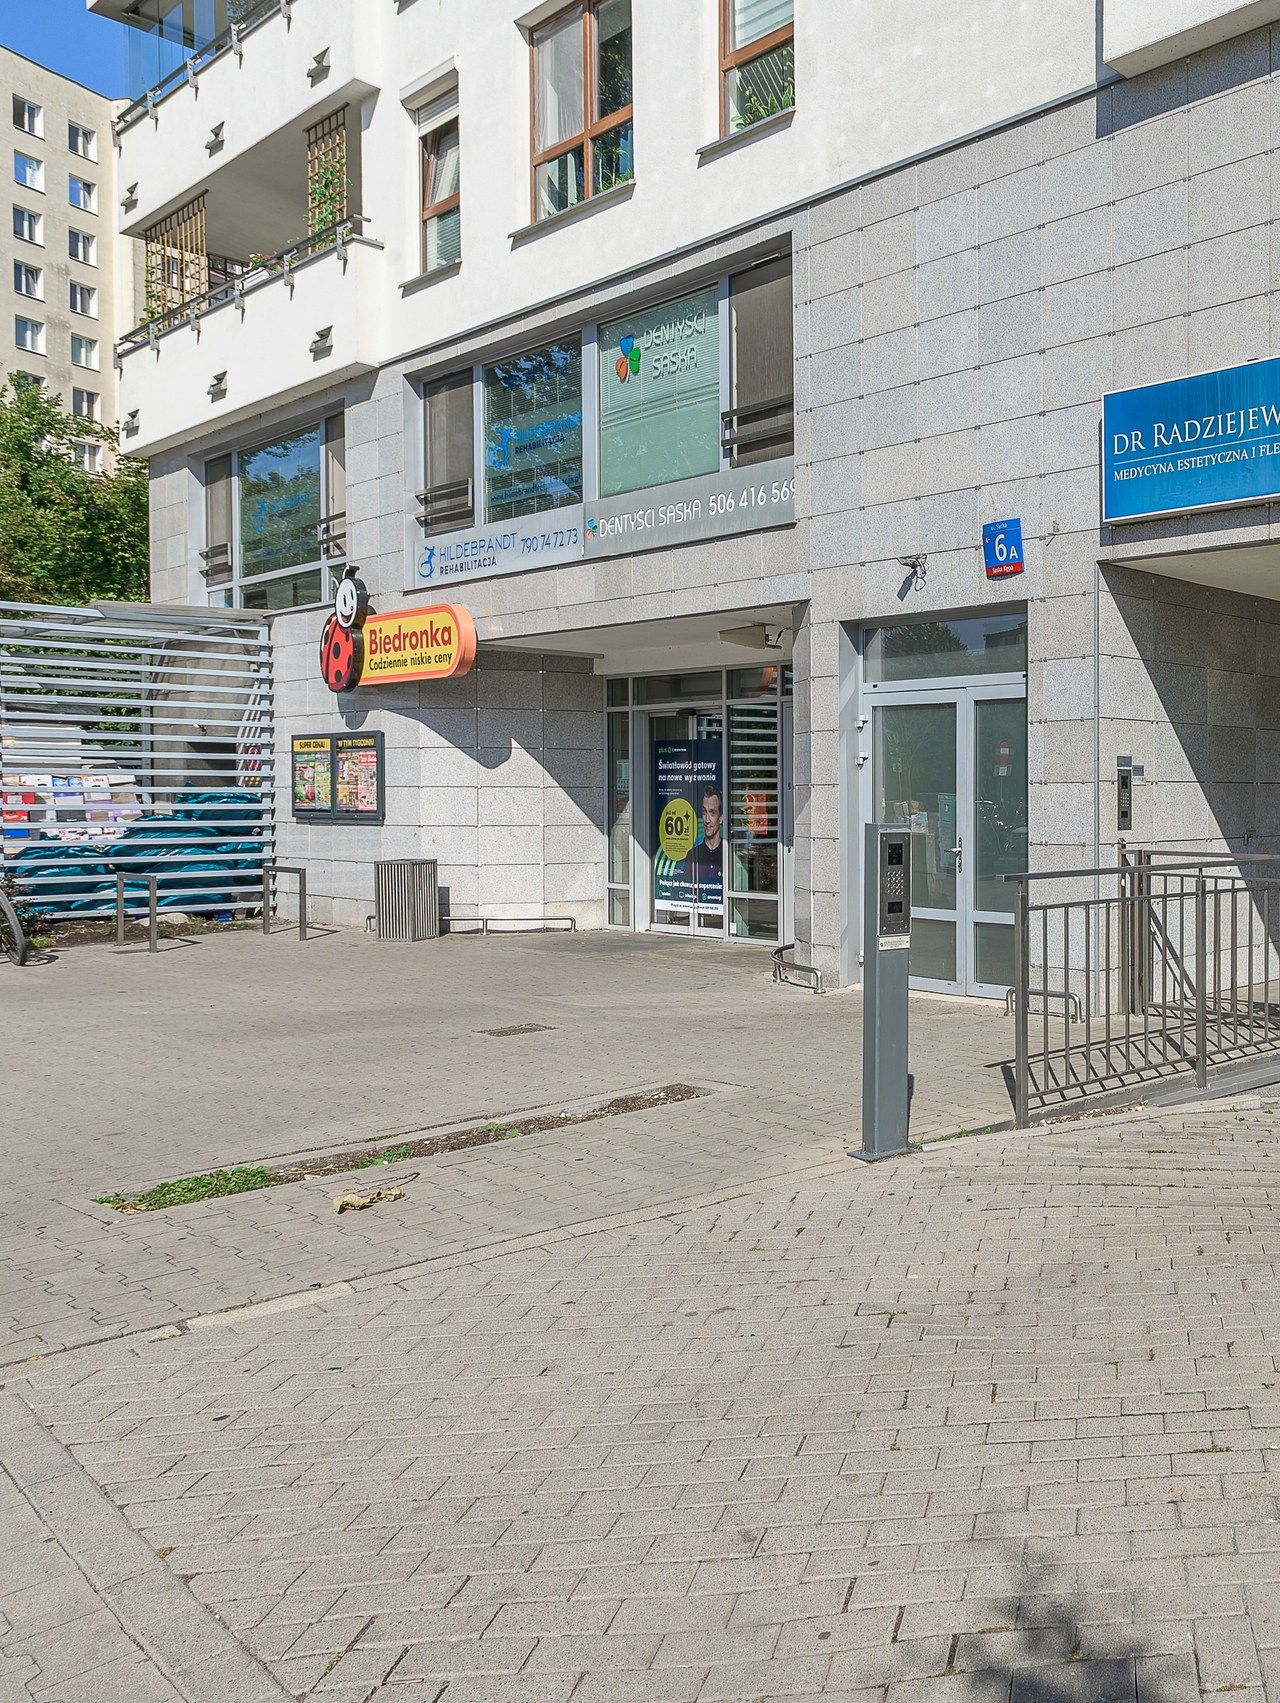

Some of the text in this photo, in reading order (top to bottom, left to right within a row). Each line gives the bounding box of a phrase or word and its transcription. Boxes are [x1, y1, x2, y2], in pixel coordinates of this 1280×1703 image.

[652, 345, 698, 380] SASKA
[1113, 430, 1145, 455] DR
[1114, 463, 1174, 481] MEDYCYNA
[1177, 450, 1249, 471] ESTETYCZNA
[1251, 446, 1257, 458] I
[599, 478, 795, 537] DENTYŚCI SASKA 506 416 569
[439, 528, 578, 562] HILDEBRANDT 790 74 72 73
[439, 556, 497, 576] REHABILITACJA
[369, 621, 452, 655] Biedronka
[369, 652, 453, 671] Codziennie niskie ceny
[693, 761, 717, 771] gotowy
[665, 816, 683, 835] 60
